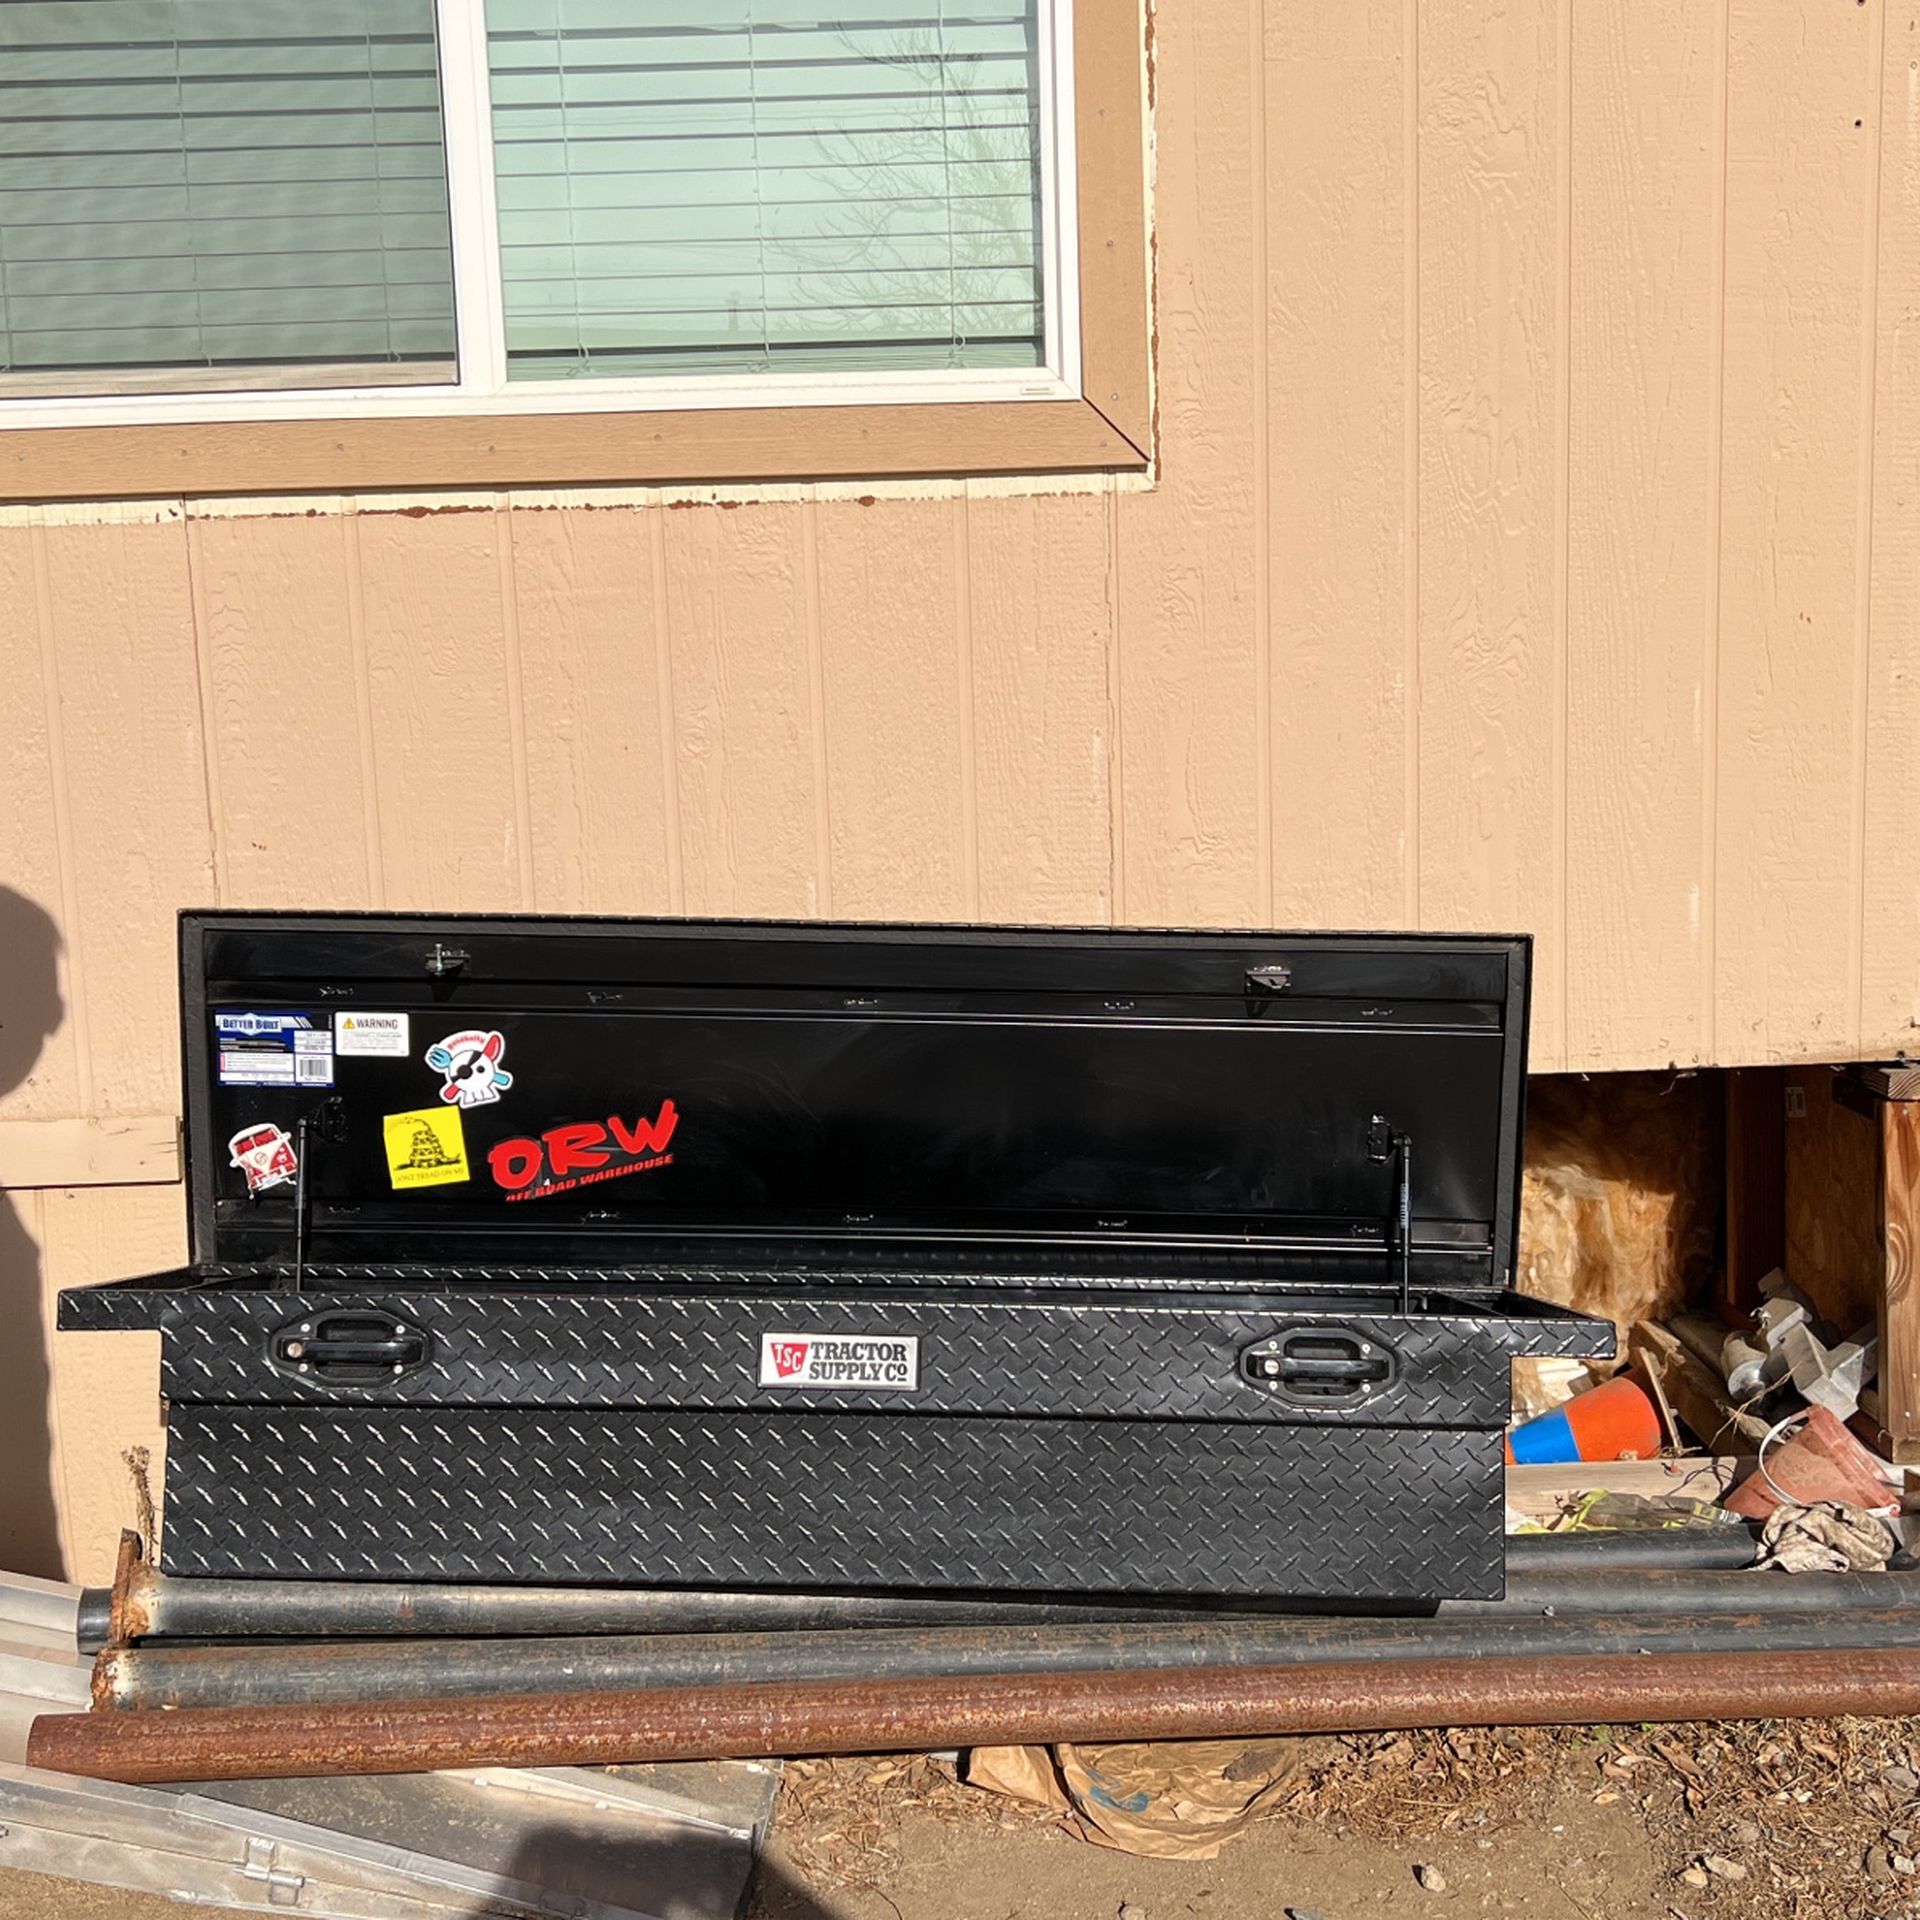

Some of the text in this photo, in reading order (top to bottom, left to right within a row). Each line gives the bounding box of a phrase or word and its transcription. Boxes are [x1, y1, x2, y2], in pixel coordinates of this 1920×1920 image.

[223, 1018, 253, 1029] BETTER
[356, 1018, 398, 1029] WARNING
[487, 1098, 679, 1190] ORW
[579, 1153, 674, 1185] WAREHOUSE
[774, 1343, 802, 1371] TSC
[810, 1341, 907, 1362] TRACTOR
[808, 1361, 883, 1380] SUPPLY
